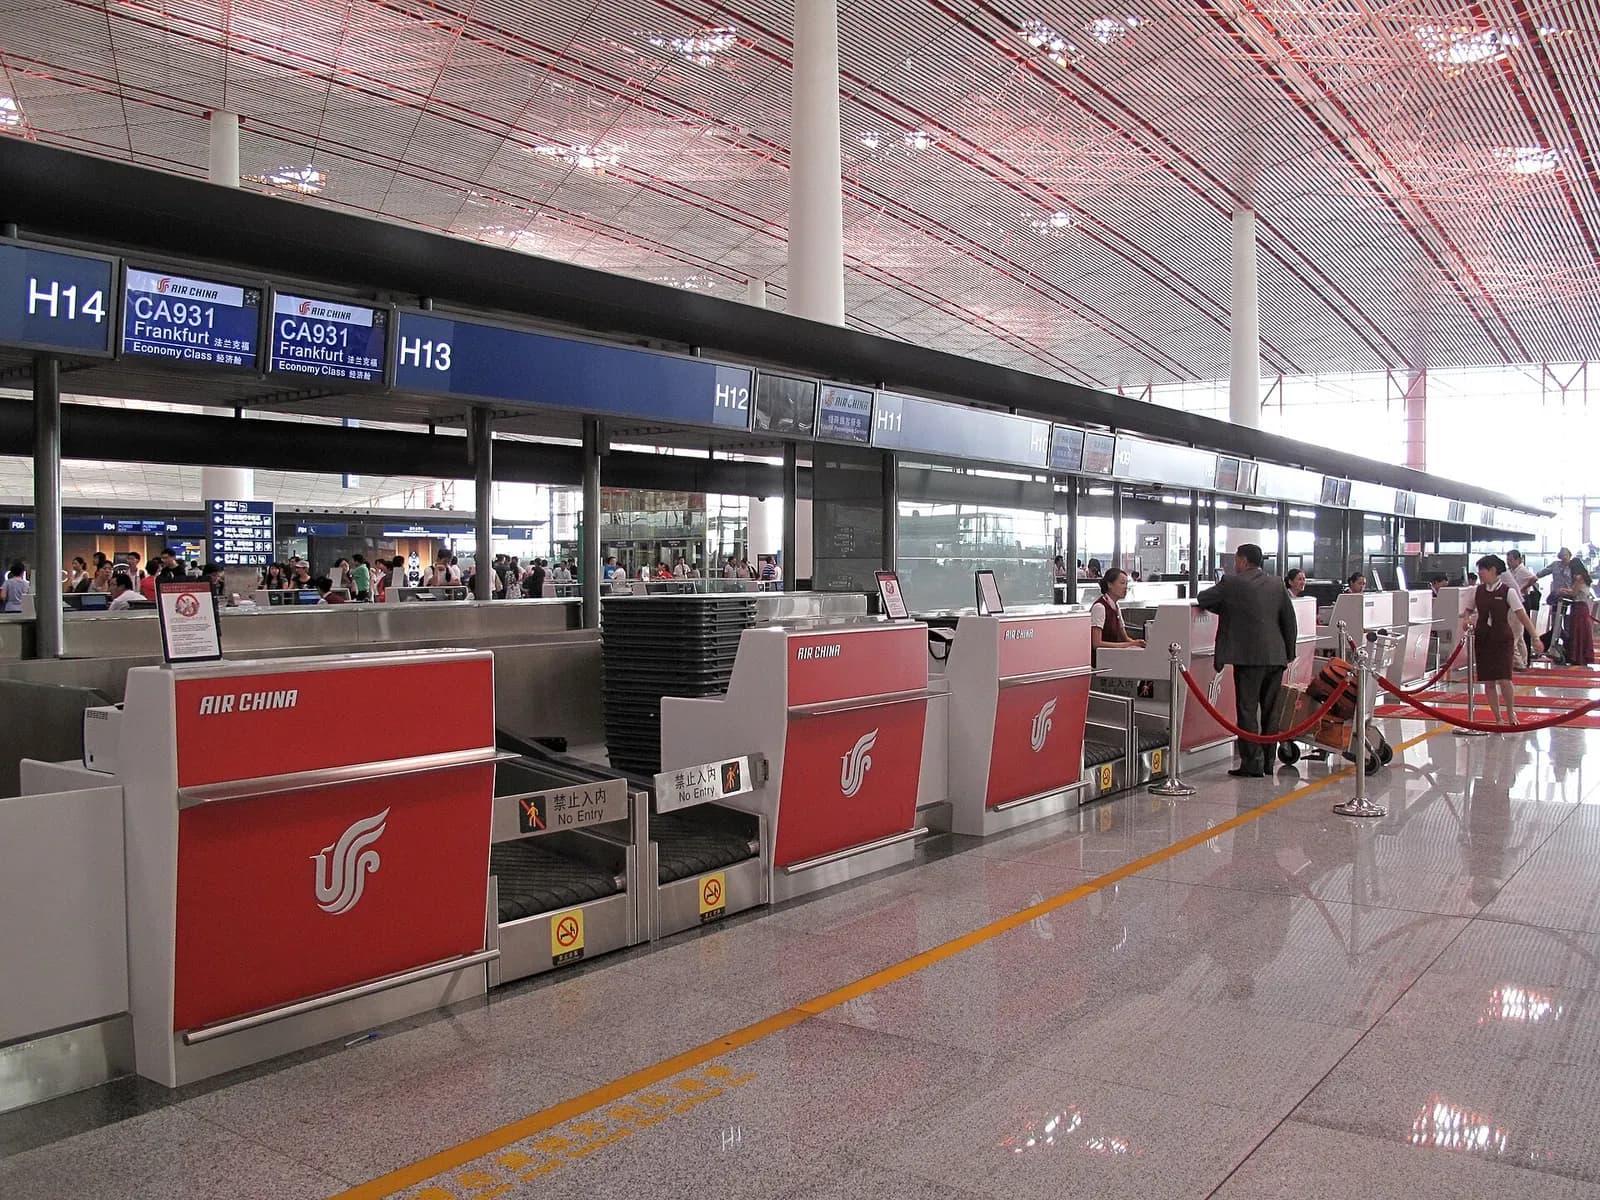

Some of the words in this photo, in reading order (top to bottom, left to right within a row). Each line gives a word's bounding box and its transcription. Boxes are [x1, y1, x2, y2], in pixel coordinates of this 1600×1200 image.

[29, 277, 106, 323] H14
[170, 284, 188, 295] AIR
[189, 287, 218, 299] CHINA
[135, 297, 214, 328] CA931
[311, 307, 326, 317] AIR
[326, 309, 352, 321] CHINA
[134, 320, 210, 345] Frankfurt
[280, 319, 348, 347] CA931
[133, 341, 182, 358] Economy
[184, 347, 212, 361] Class
[213, 337, 250, 351] 法兰克福
[280, 341, 344, 363] Frankfurt
[400, 336, 451, 371] H13
[216, 352, 242, 366] 经济舱
[279, 360, 320, 376] Economy
[321, 365, 346, 378] Class
[347, 355, 378, 368] 法兰克福
[348, 369, 371, 381] 经济舱
[715, 383, 748, 410] H12
[834, 396, 848, 409] AIR
[847, 399, 869, 411] CHINA
[877, 410, 902, 432] H11
[797, 647, 814, 661] AIR
[814, 644, 841, 659] CHINA
[200, 694, 234, 715] AIR
[238, 689, 298, 712] CHINA
[674, 767, 717, 791] 禁止入内
[553, 788, 608, 813] 禁止入内
[678, 790, 691, 803] No
[693, 785, 715, 802] Entry
[558, 812, 574, 825] No
[577, 807, 604, 823] Entry
